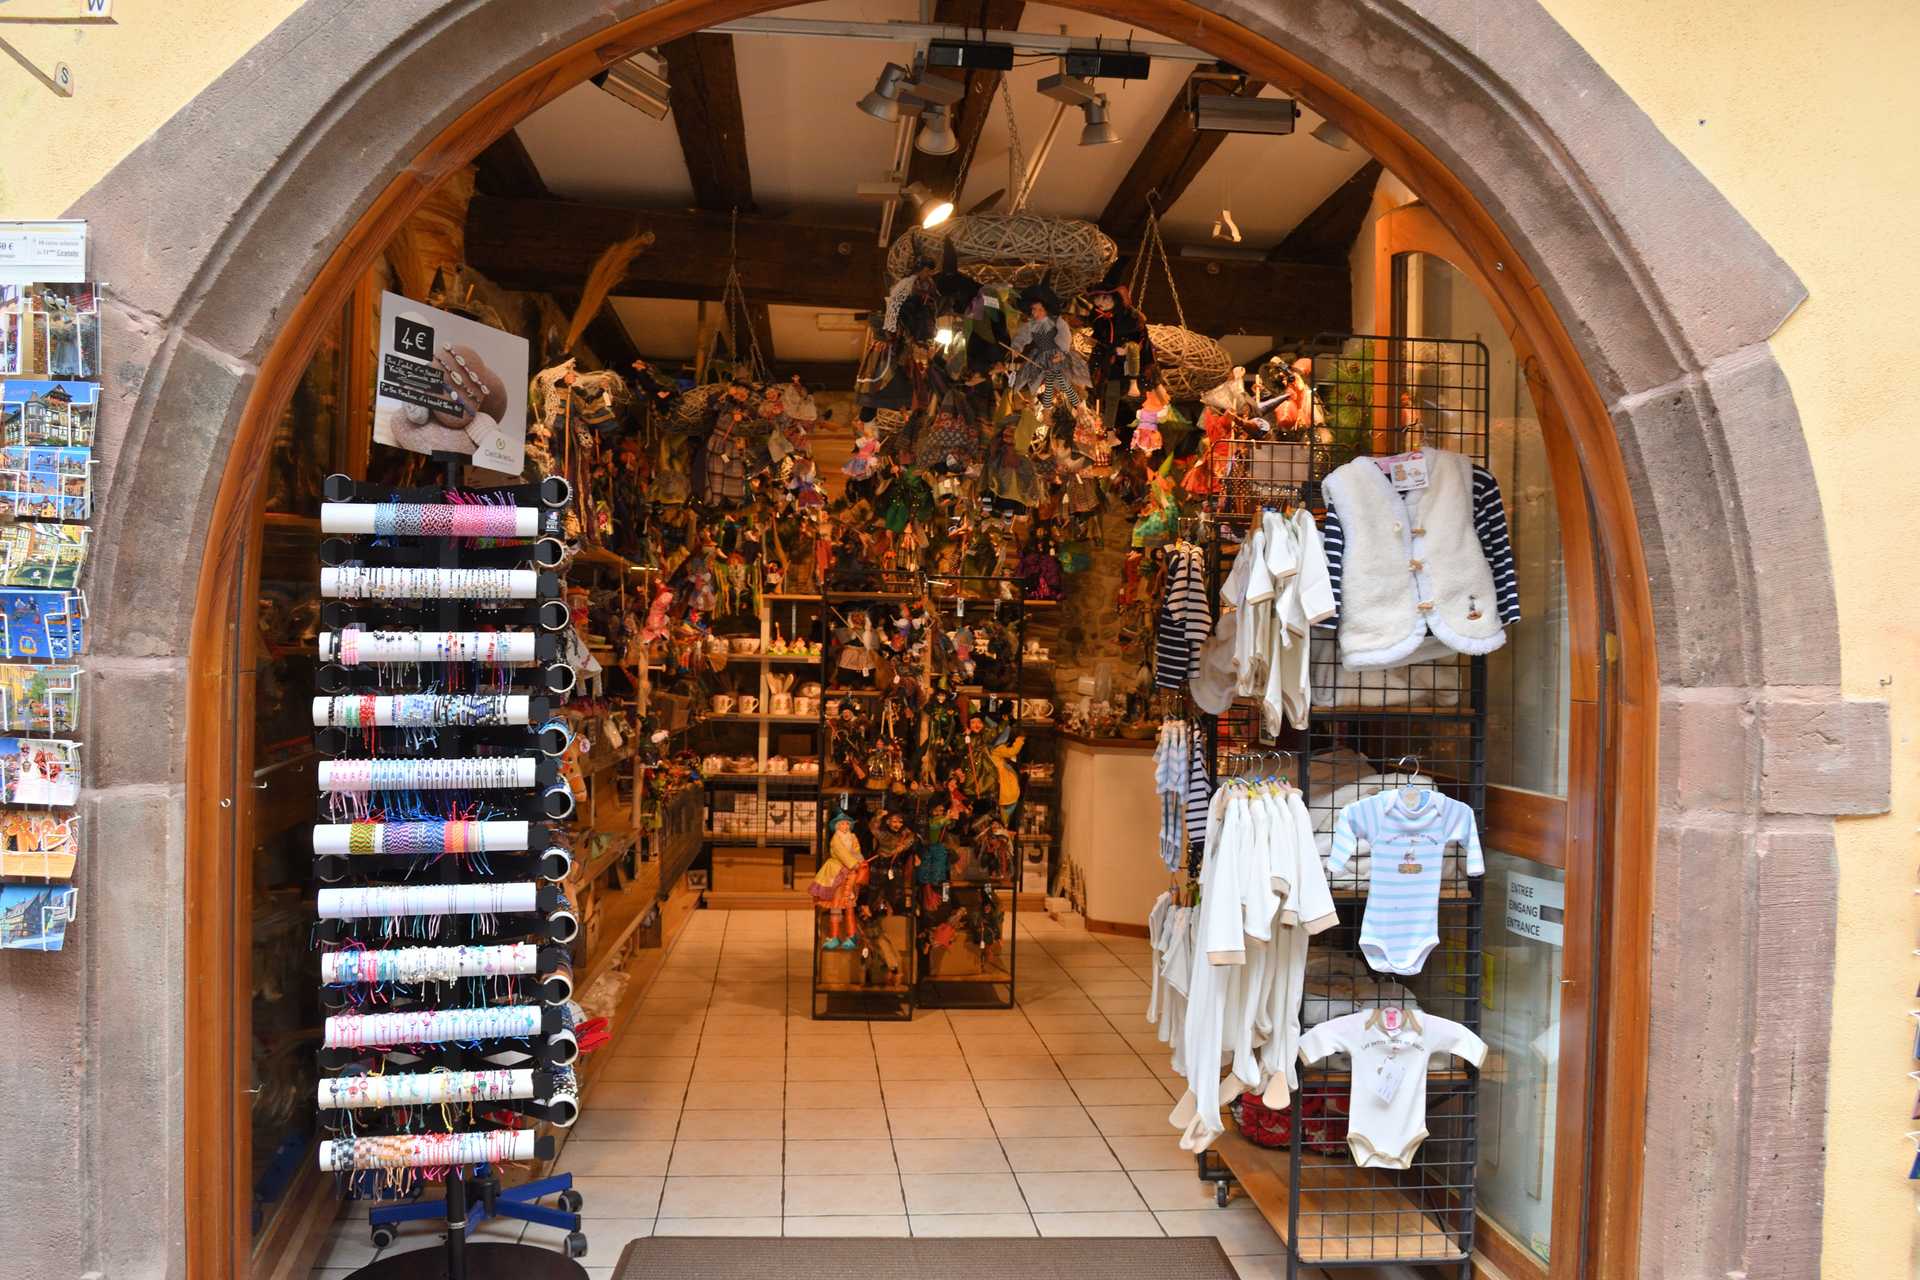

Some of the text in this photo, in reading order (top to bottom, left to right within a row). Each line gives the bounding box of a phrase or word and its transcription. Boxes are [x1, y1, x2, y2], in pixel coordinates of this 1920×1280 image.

[87, 0, 105, 11] W
[400, 326, 427, 351] 4€
[1511, 882, 1534, 898] ENTREE
[1508, 899, 1538, 918] EINGANG
[1506, 916, 1541, 937] ENTRANCE
